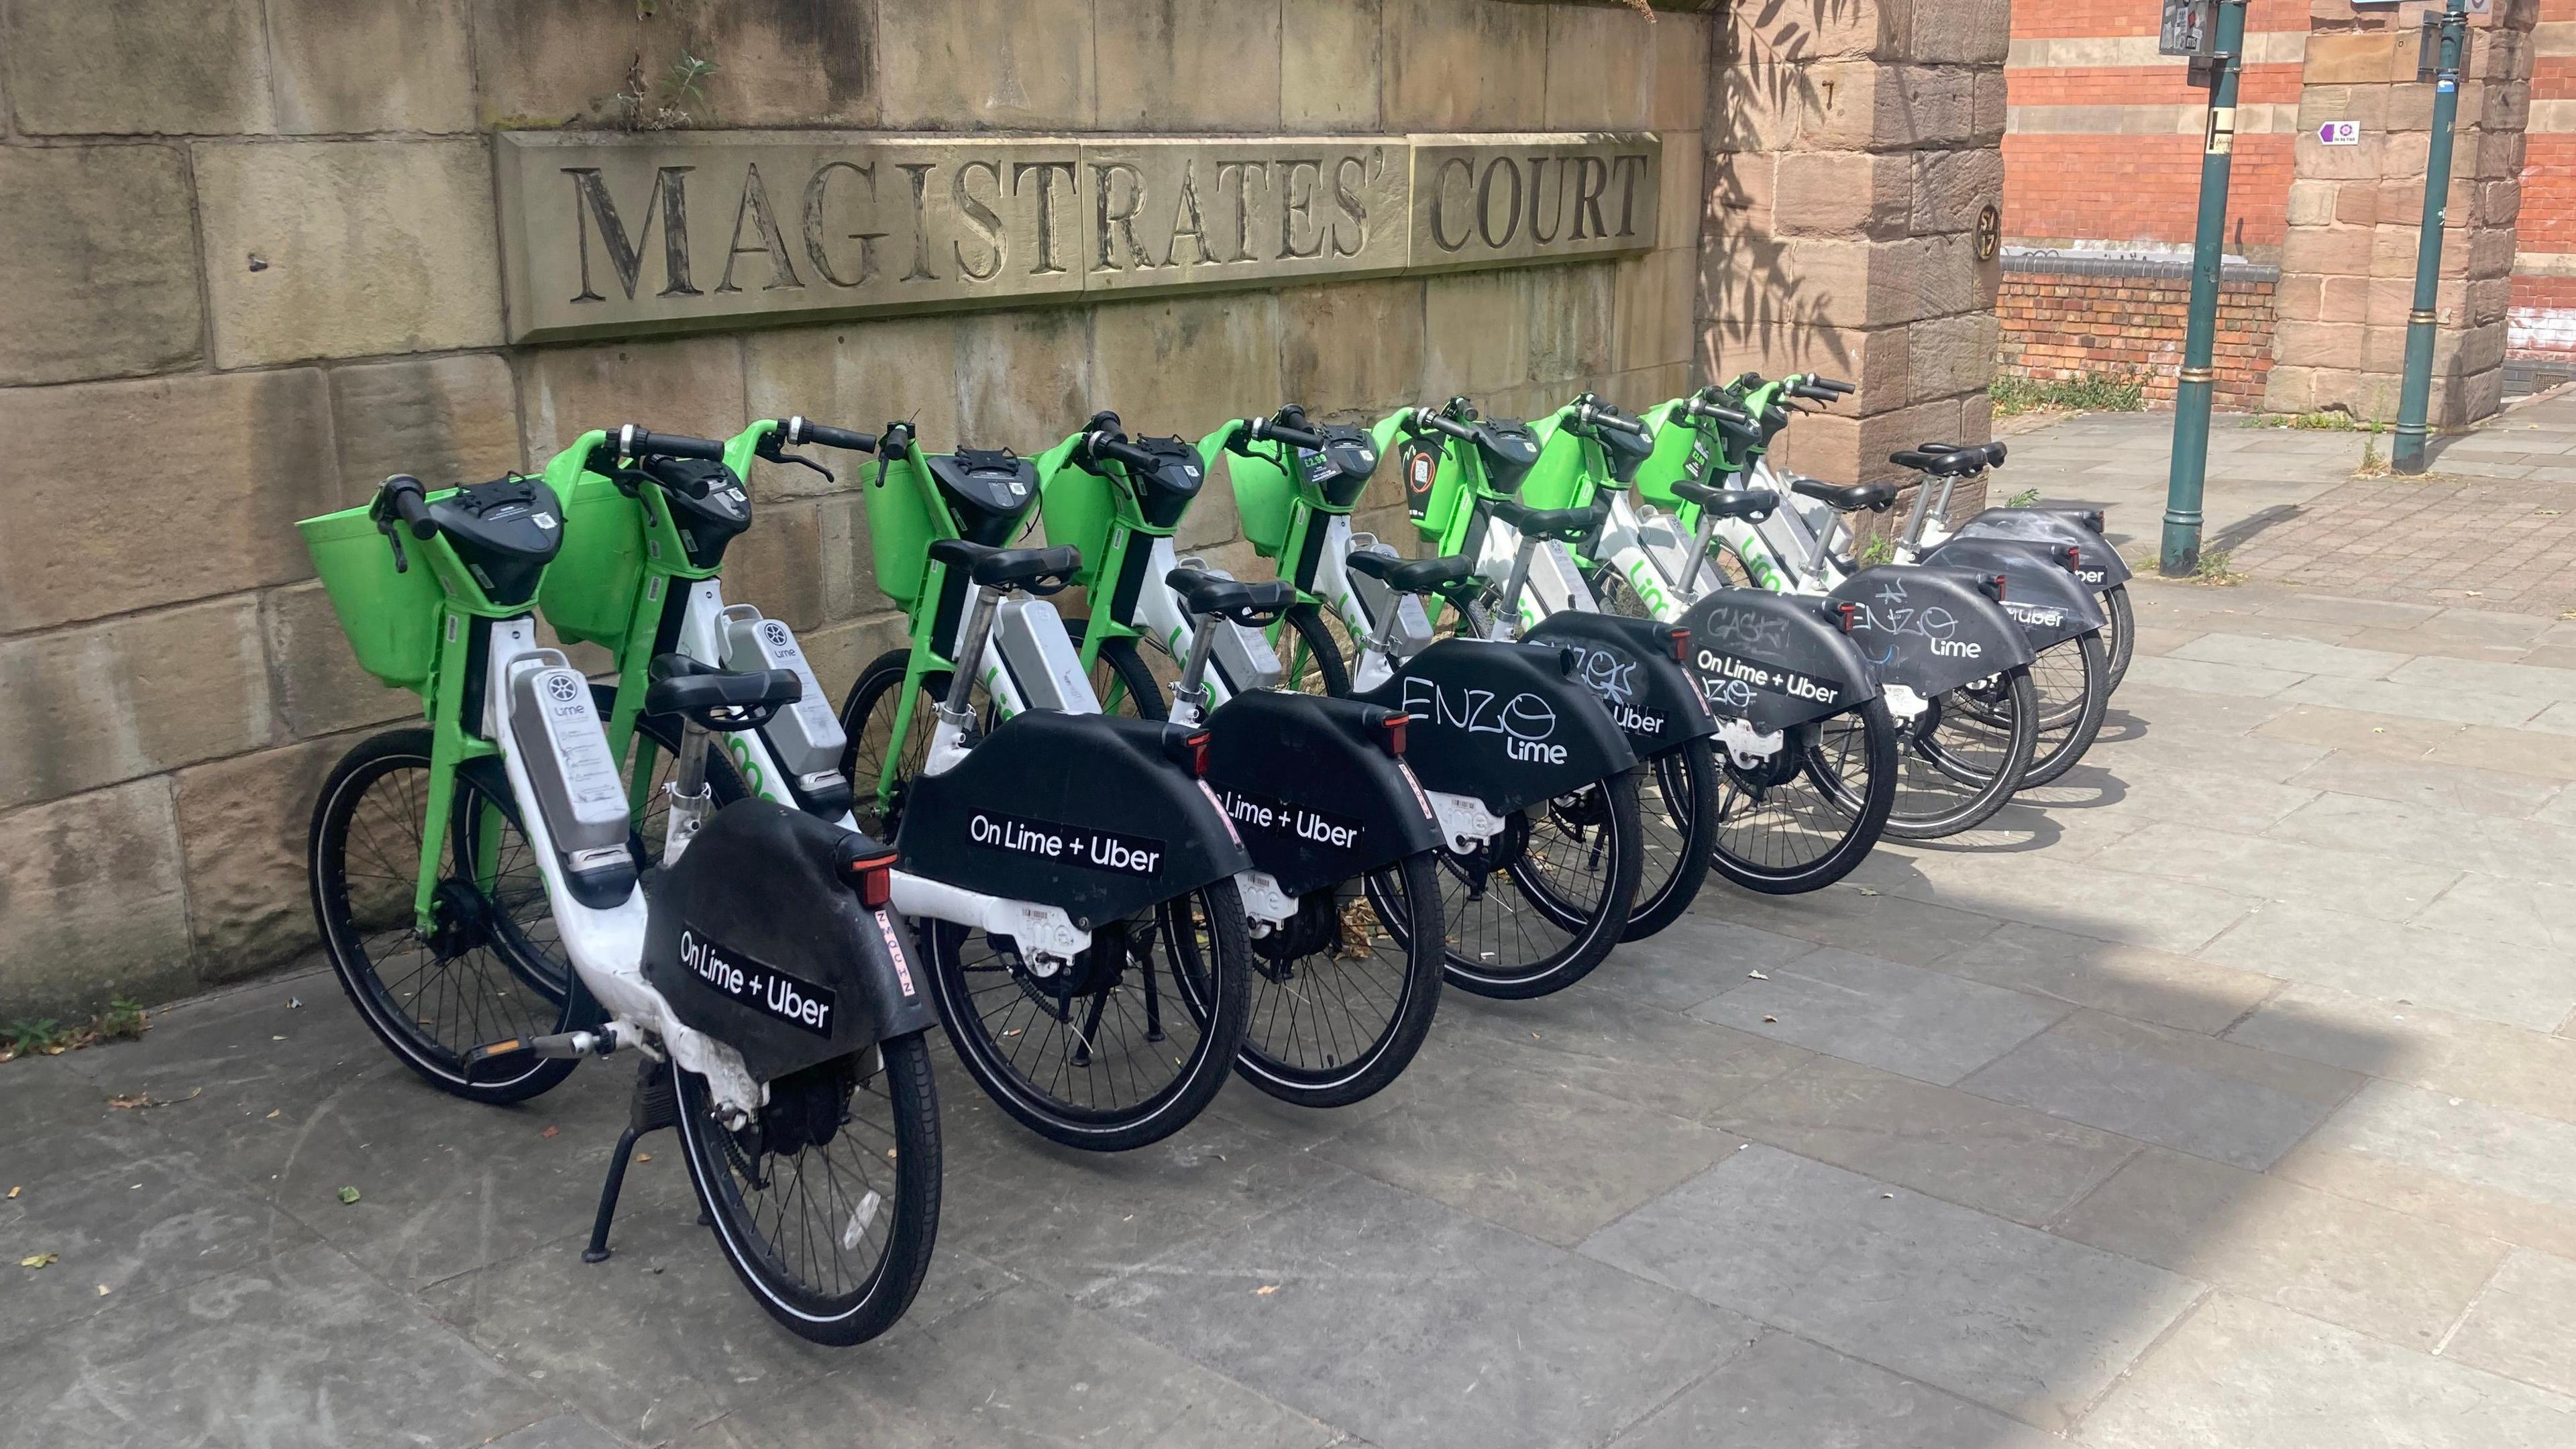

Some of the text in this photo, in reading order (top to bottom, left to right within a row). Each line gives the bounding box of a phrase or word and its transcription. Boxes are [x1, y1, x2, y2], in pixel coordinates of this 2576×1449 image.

[560, 145, 1648, 304] MAGISTRATES' COURT
[1304, 453, 1327, 468] £2.99
[1629, 559, 1670, 616] Lim
[1741, 535, 1781, 593] Lim
[774, 649, 796, 658] Lime
[1931, 637, 1982, 658] Lime
[1697, 649, 1838, 704] On Lime + Uber
[555, 705, 585, 716] Lime
[1401, 676, 1556, 741] ENZO
[1613, 705, 1664, 733] Uber
[1507, 737, 1568, 765] Lime
[971, 814, 1159, 873] On Lime + Uber
[1226, 791, 1273, 827] Lime
[1278, 811, 1291, 827] +
[1296, 810, 1357, 849] Uber
[680, 930, 829, 1028] On Lime + Uber
